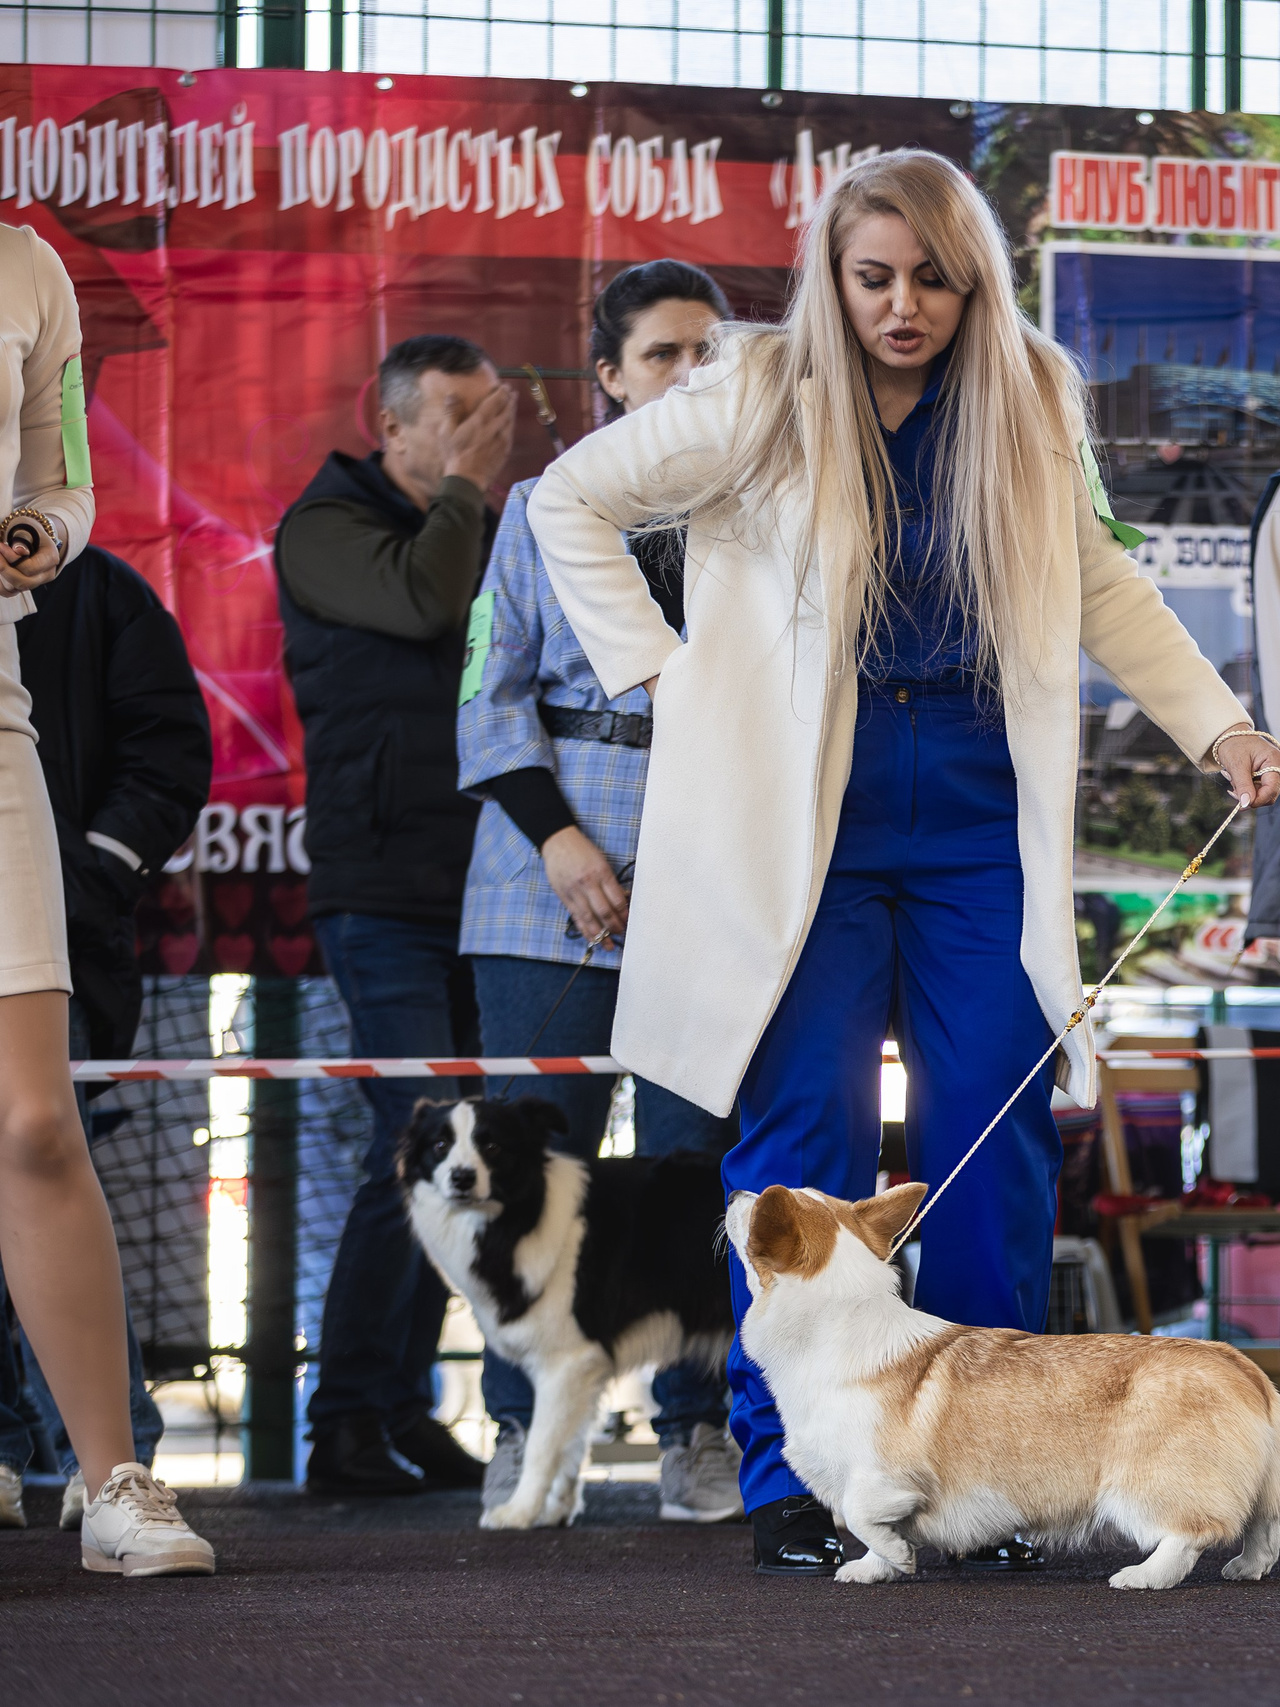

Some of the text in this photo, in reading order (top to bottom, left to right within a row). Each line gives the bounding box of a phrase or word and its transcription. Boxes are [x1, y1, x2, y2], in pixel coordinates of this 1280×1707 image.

[277, 121, 564, 231] ПОРОДИСТЫХ
[586, 132, 723, 225] СОБАК
[1057, 156, 1147, 227] КЛУБ
